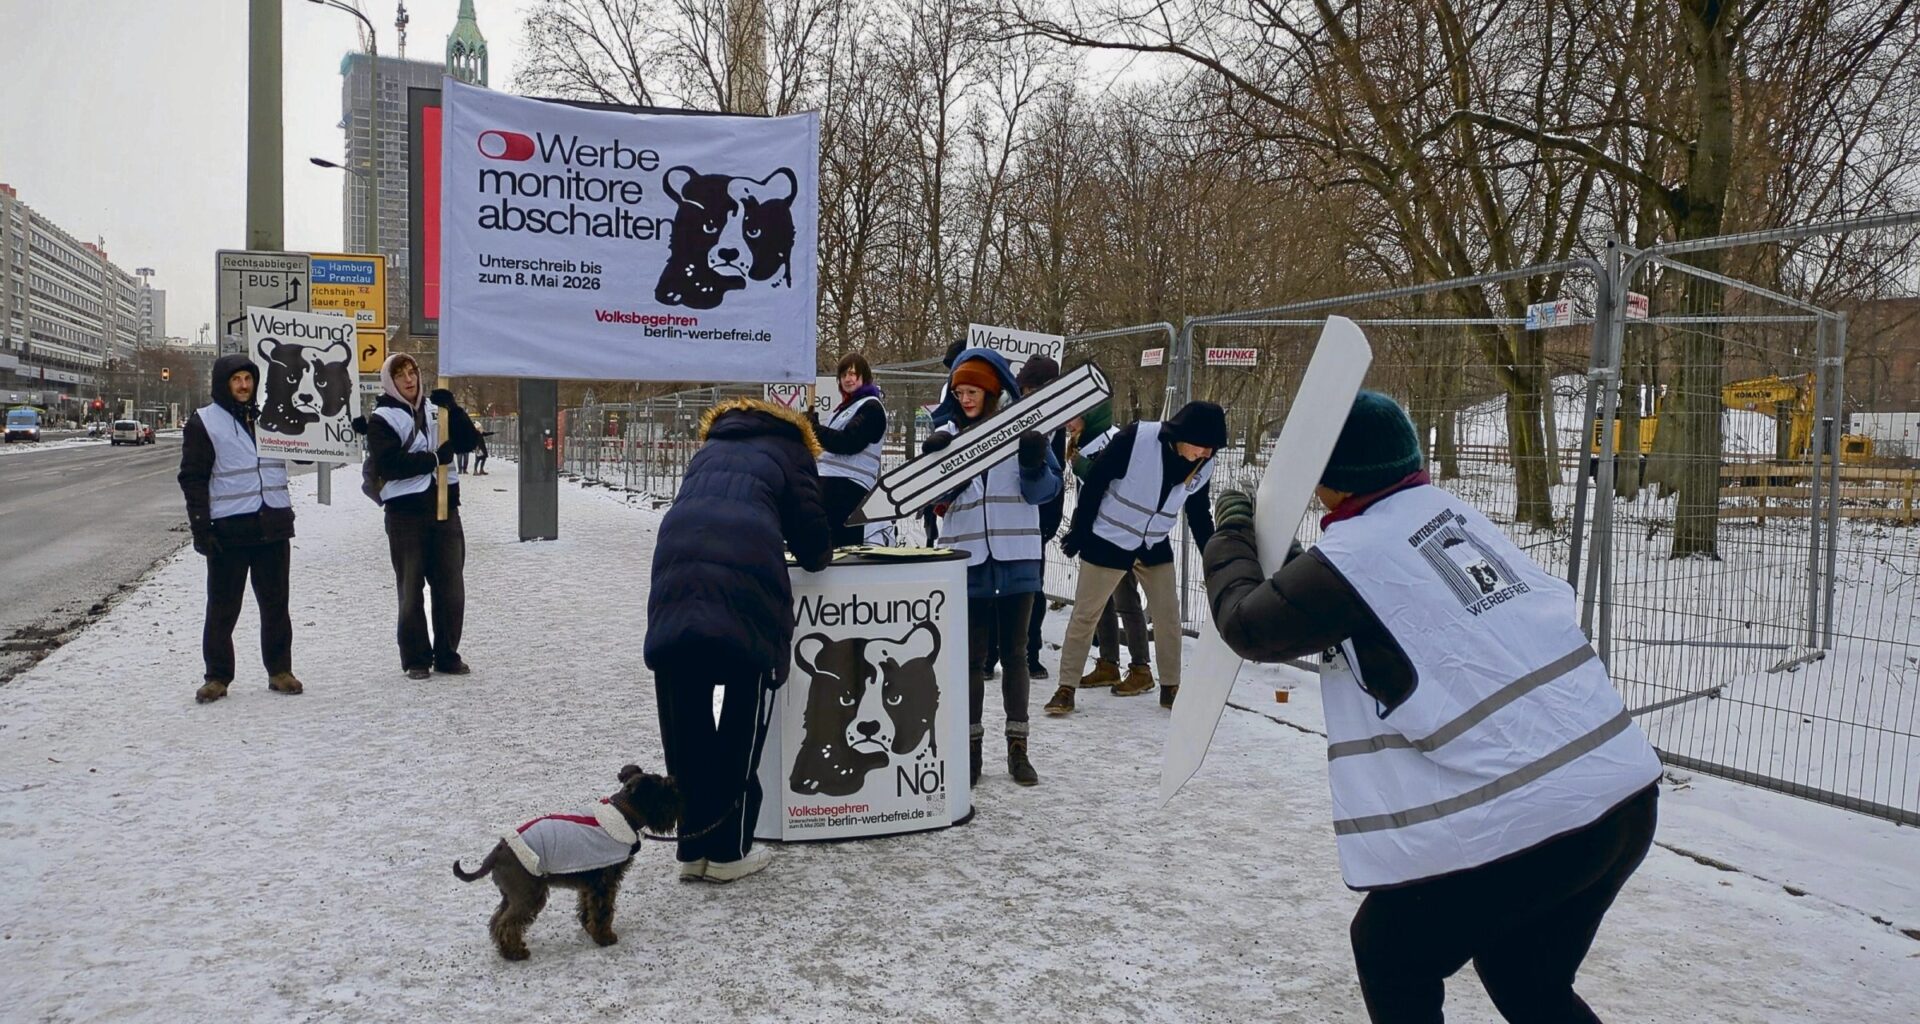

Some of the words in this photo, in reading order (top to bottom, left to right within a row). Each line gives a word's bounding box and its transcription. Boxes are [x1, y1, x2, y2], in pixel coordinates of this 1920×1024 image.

[536, 132, 660, 172] Werbe
[478, 168, 643, 205] monitore
[478, 198, 675, 240] abschalten
[223, 257, 303, 270] Rechtsabbieger
[329, 262, 372, 274] Hamburg
[479, 254, 576, 273] Unterschreib
[580, 261, 602, 274] bis
[249, 275, 280, 288] BUS
[329, 274, 371, 283] Prenzlau
[478, 273, 512, 285] zum
[515, 273, 528, 286] 8.
[531, 273, 558, 287] Mai
[562, 275, 601, 290] 2026
[312, 287, 355, 296] richshain
[343, 299, 366, 308] Berg
[356, 313, 373, 321] bcc
[595, 309, 698, 327] Volksbegehren
[251, 313, 353, 343] Werbung?
[643, 325, 772, 342] berlin-werbefrei.de
[971, 329, 1061, 358] Werbung?
[1208, 350, 1255, 359] RUHNKE
[325, 423, 358, 443] Nö!
[940, 454, 967, 475] Jetzt
[966, 409, 1044, 460] unterschreiben!
[1466, 581, 1531, 617] WERBEFREI
[793, 590, 946, 627] Werbung?
[897, 760, 945, 797] Nö!
[788, 803, 870, 818] Volksbegehren
[828, 809, 924, 827] berlin-werbefrei.de
